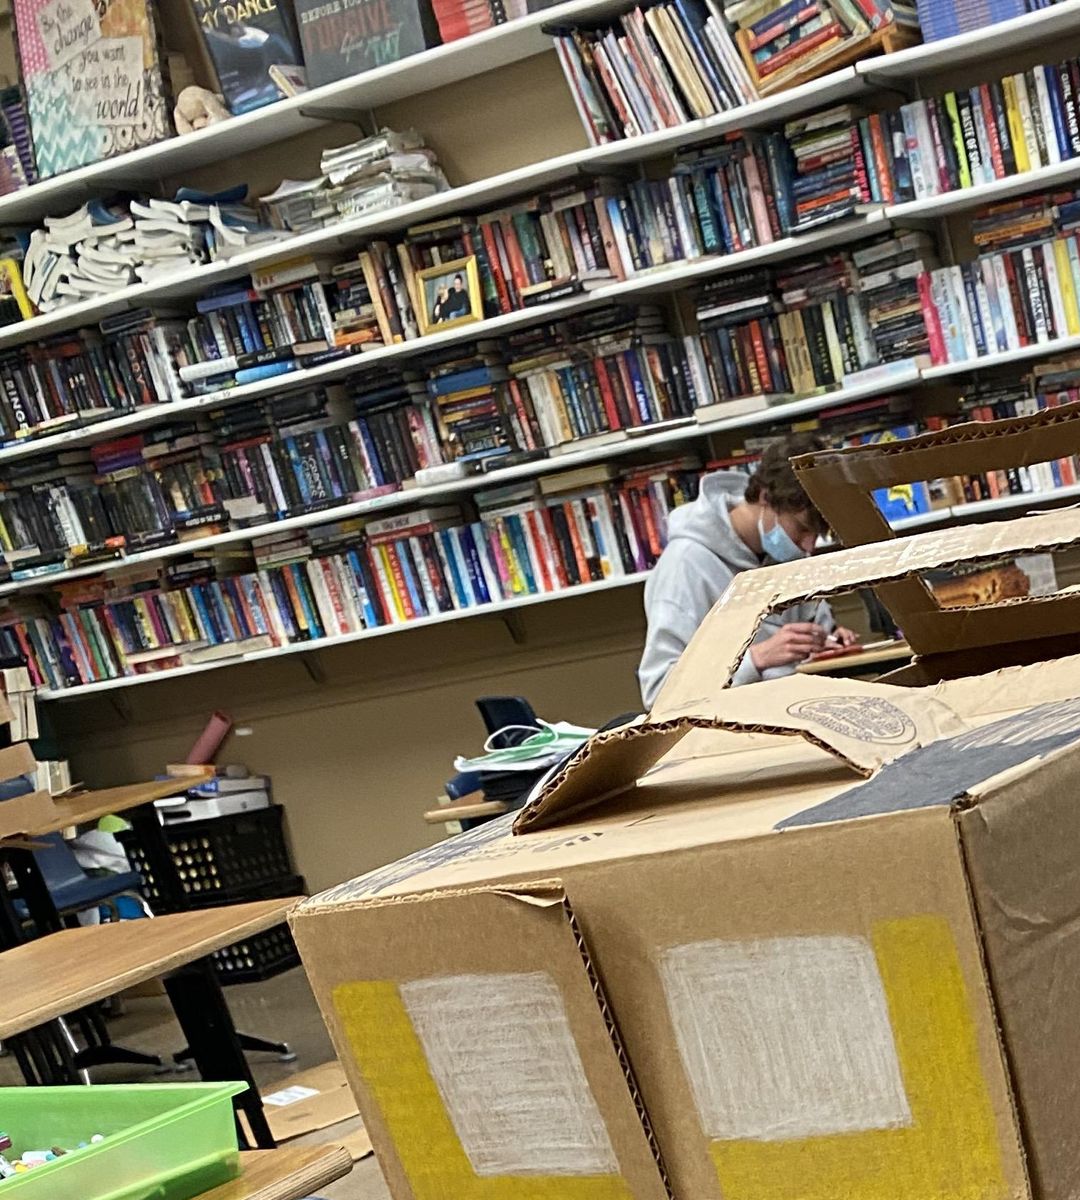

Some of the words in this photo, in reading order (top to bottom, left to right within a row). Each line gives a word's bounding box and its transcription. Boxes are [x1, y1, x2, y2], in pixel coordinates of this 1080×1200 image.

[54, 14, 94, 56] change
[79, 49, 100, 72] you
[102, 44, 127, 63] want
[85, 77, 98, 93] see
[113, 66, 130, 89] the
[1059, 72, 1074, 99] GIRL
[95, 80, 142, 120] world
[960, 106, 978, 138] WASTE
[1064, 100, 1080, 135] MANS
[966, 136, 979, 151] OF
